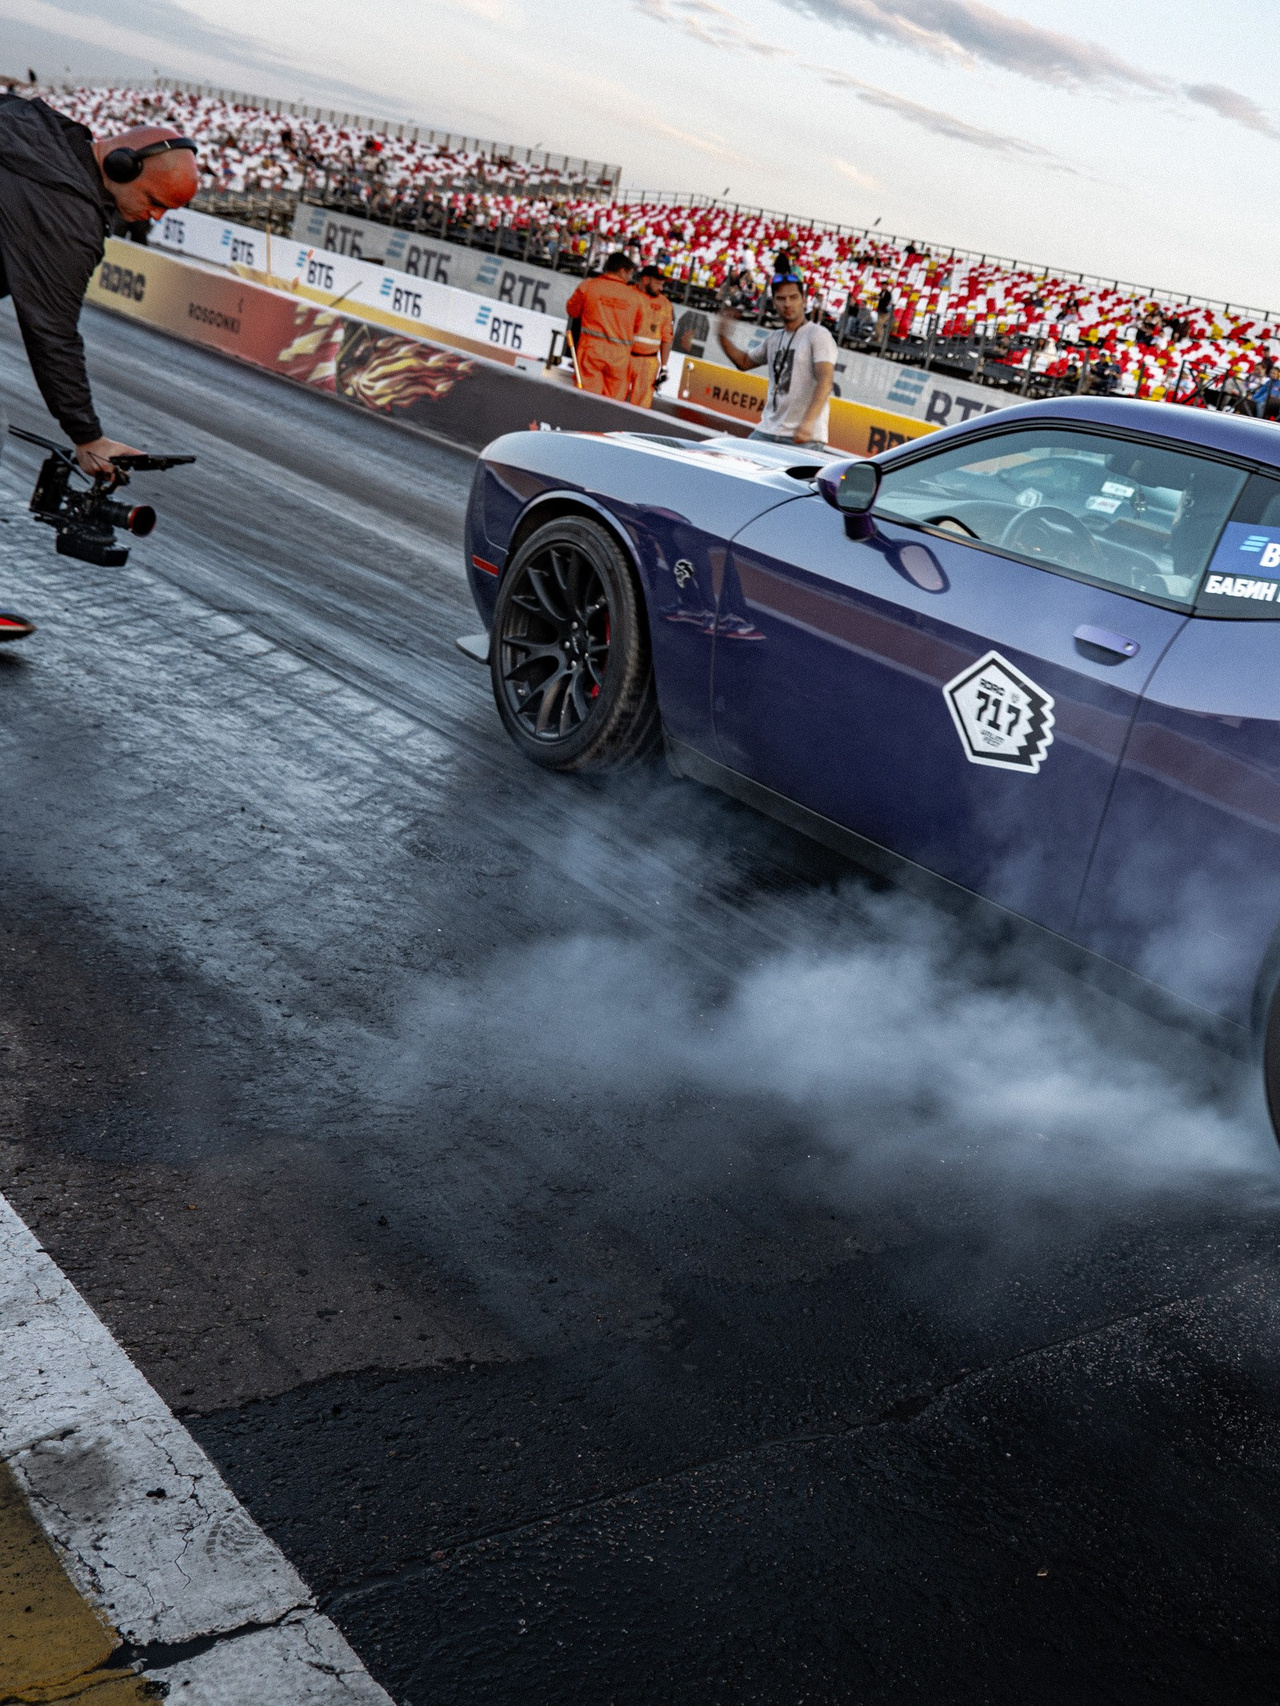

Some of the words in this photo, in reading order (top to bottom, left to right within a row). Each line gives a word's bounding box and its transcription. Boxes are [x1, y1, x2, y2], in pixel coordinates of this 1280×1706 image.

[163, 217, 185, 244] ВТБ
[324, 221, 364, 258] ВТБ
[231, 238, 254, 266] ВТБ
[405, 245, 453, 285] ВТБ
[306, 260, 334, 290] ВТБ
[392, 287, 423, 318] ВТБ
[499, 270, 551, 314] ВТБ
[489, 317, 525, 350] ВТБ
[1204, 574, 1278, 602] БАБИН
[976, 690, 1022, 737] 717
